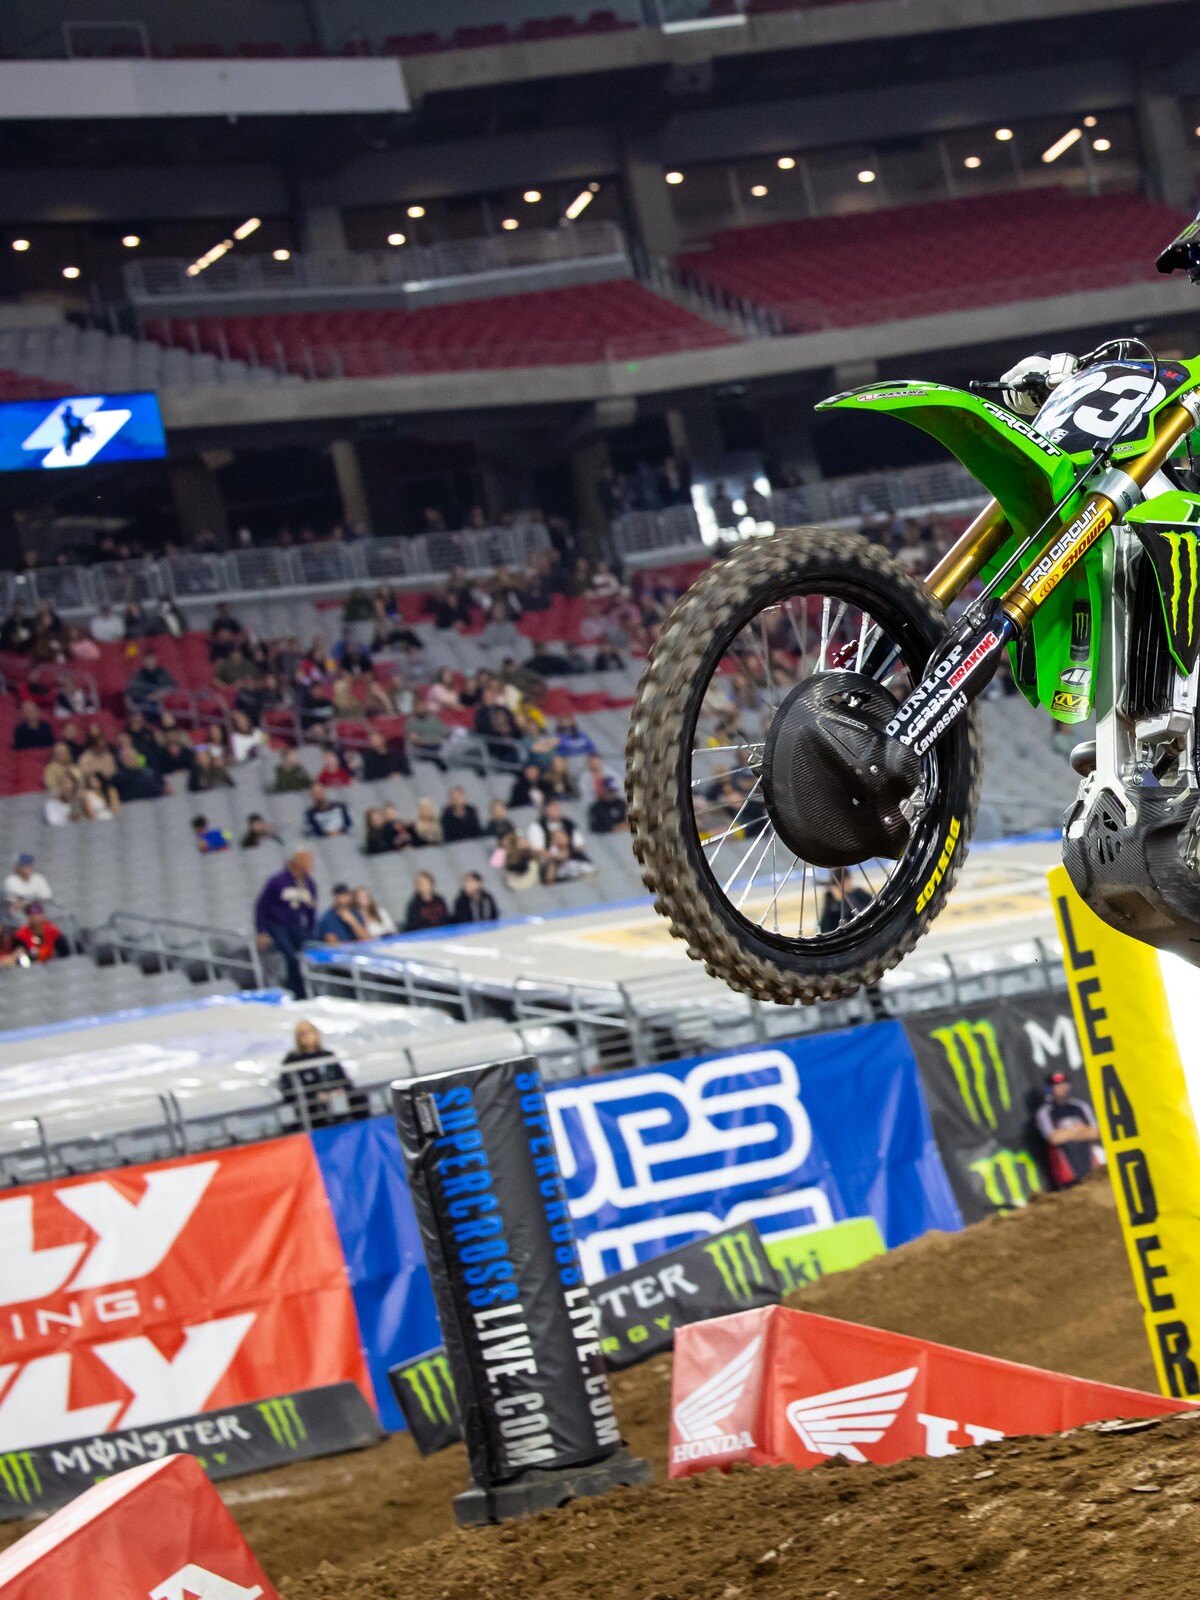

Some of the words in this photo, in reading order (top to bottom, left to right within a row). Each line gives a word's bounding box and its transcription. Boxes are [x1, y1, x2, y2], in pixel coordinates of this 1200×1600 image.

[983, 402, 1061, 456] CIRCUIT
[1022, 556, 1053, 592] PRO
[1048, 501, 1099, 561] CIRCUIT
[1061, 517, 1106, 574] SHOWA
[949, 632, 997, 689] BRAKING
[886, 645, 963, 737] DUNLOP
[913, 691, 969, 757] Kawasaki
[0, 1160, 220, 1305] LY
[598, 1264, 698, 1318] TER
[0, 1312, 257, 1454] LY
[51, 1414, 251, 1474] MONSTER
[673, 1431, 757, 1463] HONDA
